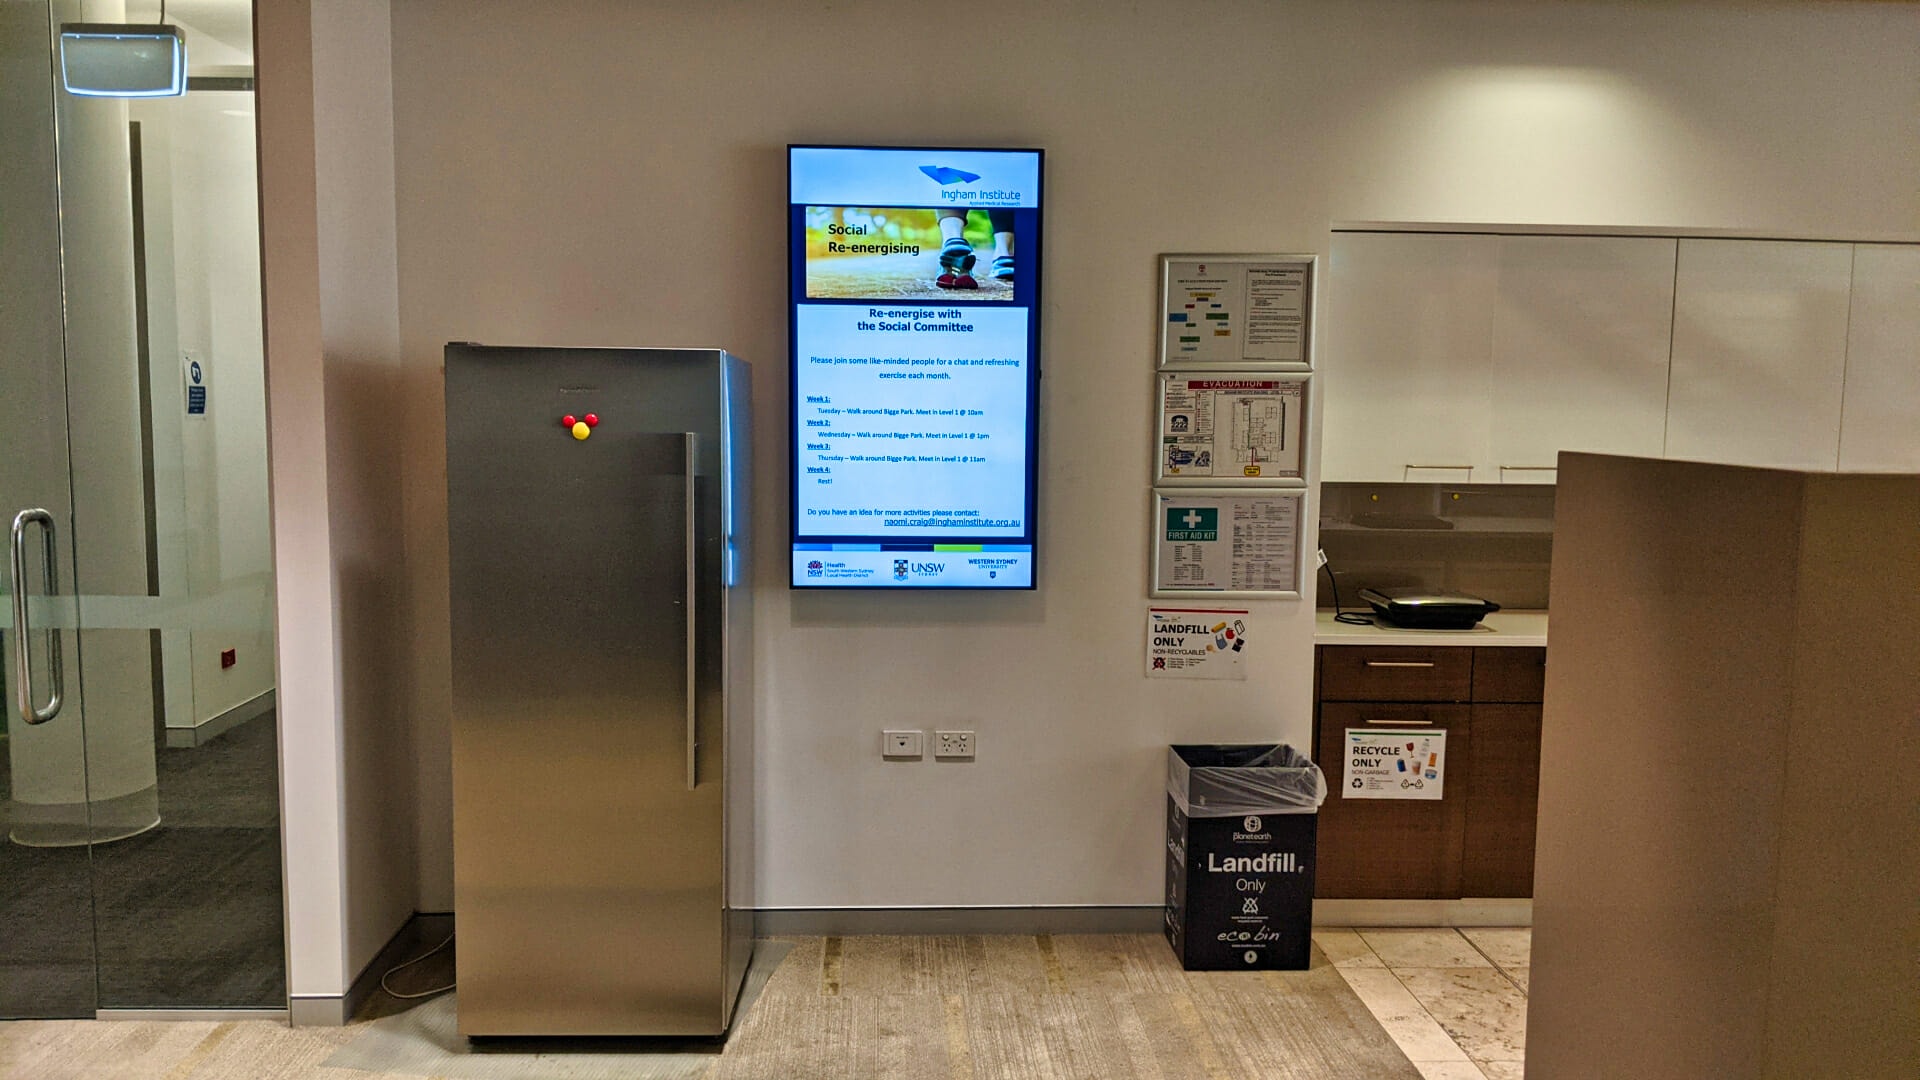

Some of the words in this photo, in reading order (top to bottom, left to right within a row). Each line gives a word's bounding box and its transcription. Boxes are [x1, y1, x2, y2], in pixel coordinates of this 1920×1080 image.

[942, 190, 976, 201] Ingham
[980, 190, 1020, 200] Institute
[828, 224, 867, 235] Social
[828, 242, 920, 256] Re-energising
[870, 309, 934, 320] Re-energise
[938, 310, 962, 319] with
[857, 322, 876, 331] the
[878, 322, 910, 331] Social
[914, 322, 974, 331] Committee
[834, 357, 847, 366] join
[912, 357, 934, 367] people
[954, 357, 968, 365] chat
[970, 357, 983, 366] and
[985, 358, 1019, 367] refreshing
[911, 563, 945, 572] UNSW
[1154, 624, 1209, 634] LANDFILL
[1154, 637, 1184, 646] ONLY
[1353, 746, 1400, 755] RECYCLE
[1352, 759, 1381, 767] ONLY
[1236, 878, 1266, 893] Only
